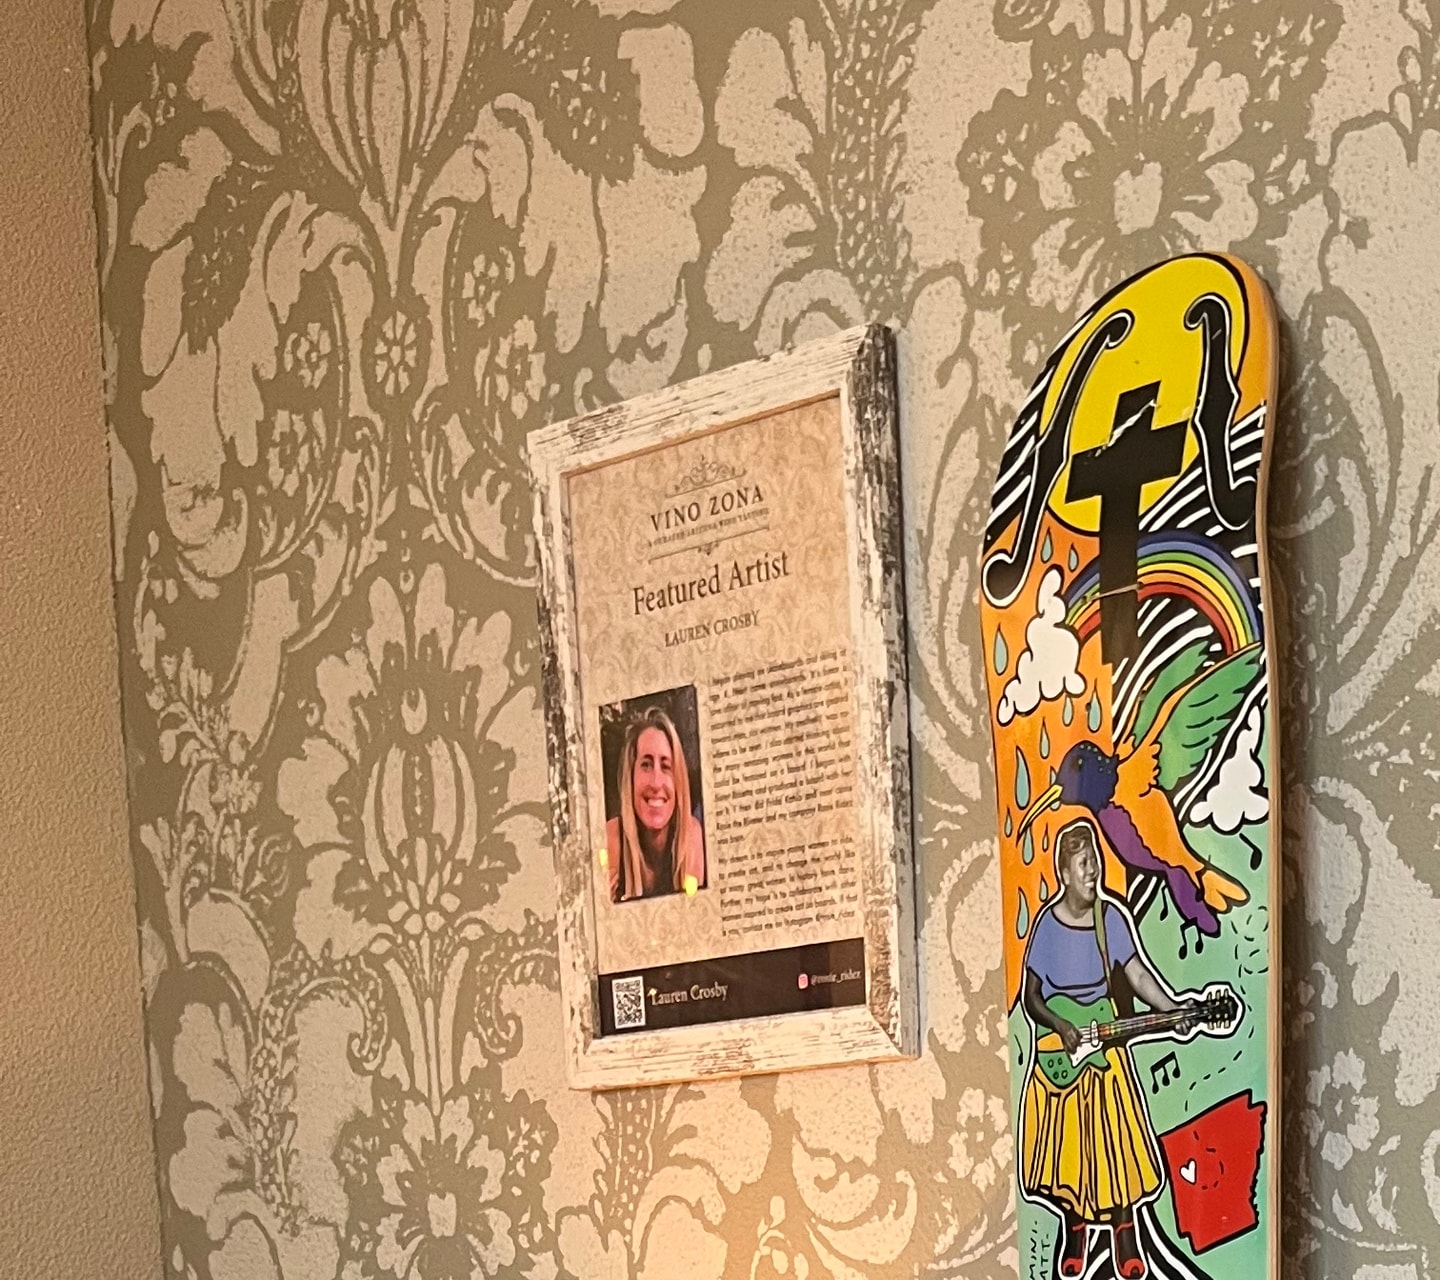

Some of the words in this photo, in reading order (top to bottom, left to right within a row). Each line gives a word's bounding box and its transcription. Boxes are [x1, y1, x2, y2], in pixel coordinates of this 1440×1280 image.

[650, 502, 700, 532] VINO
[709, 485, 764, 515] ZONA
[633, 564, 720, 615] Featured
[729, 551, 790, 591] Artist
[665, 622, 711, 647] LAUREN
[713, 609, 760, 635] CROSBY
[650, 988, 687, 1006] Lauren
[690, 981, 728, 1001] Crosby
